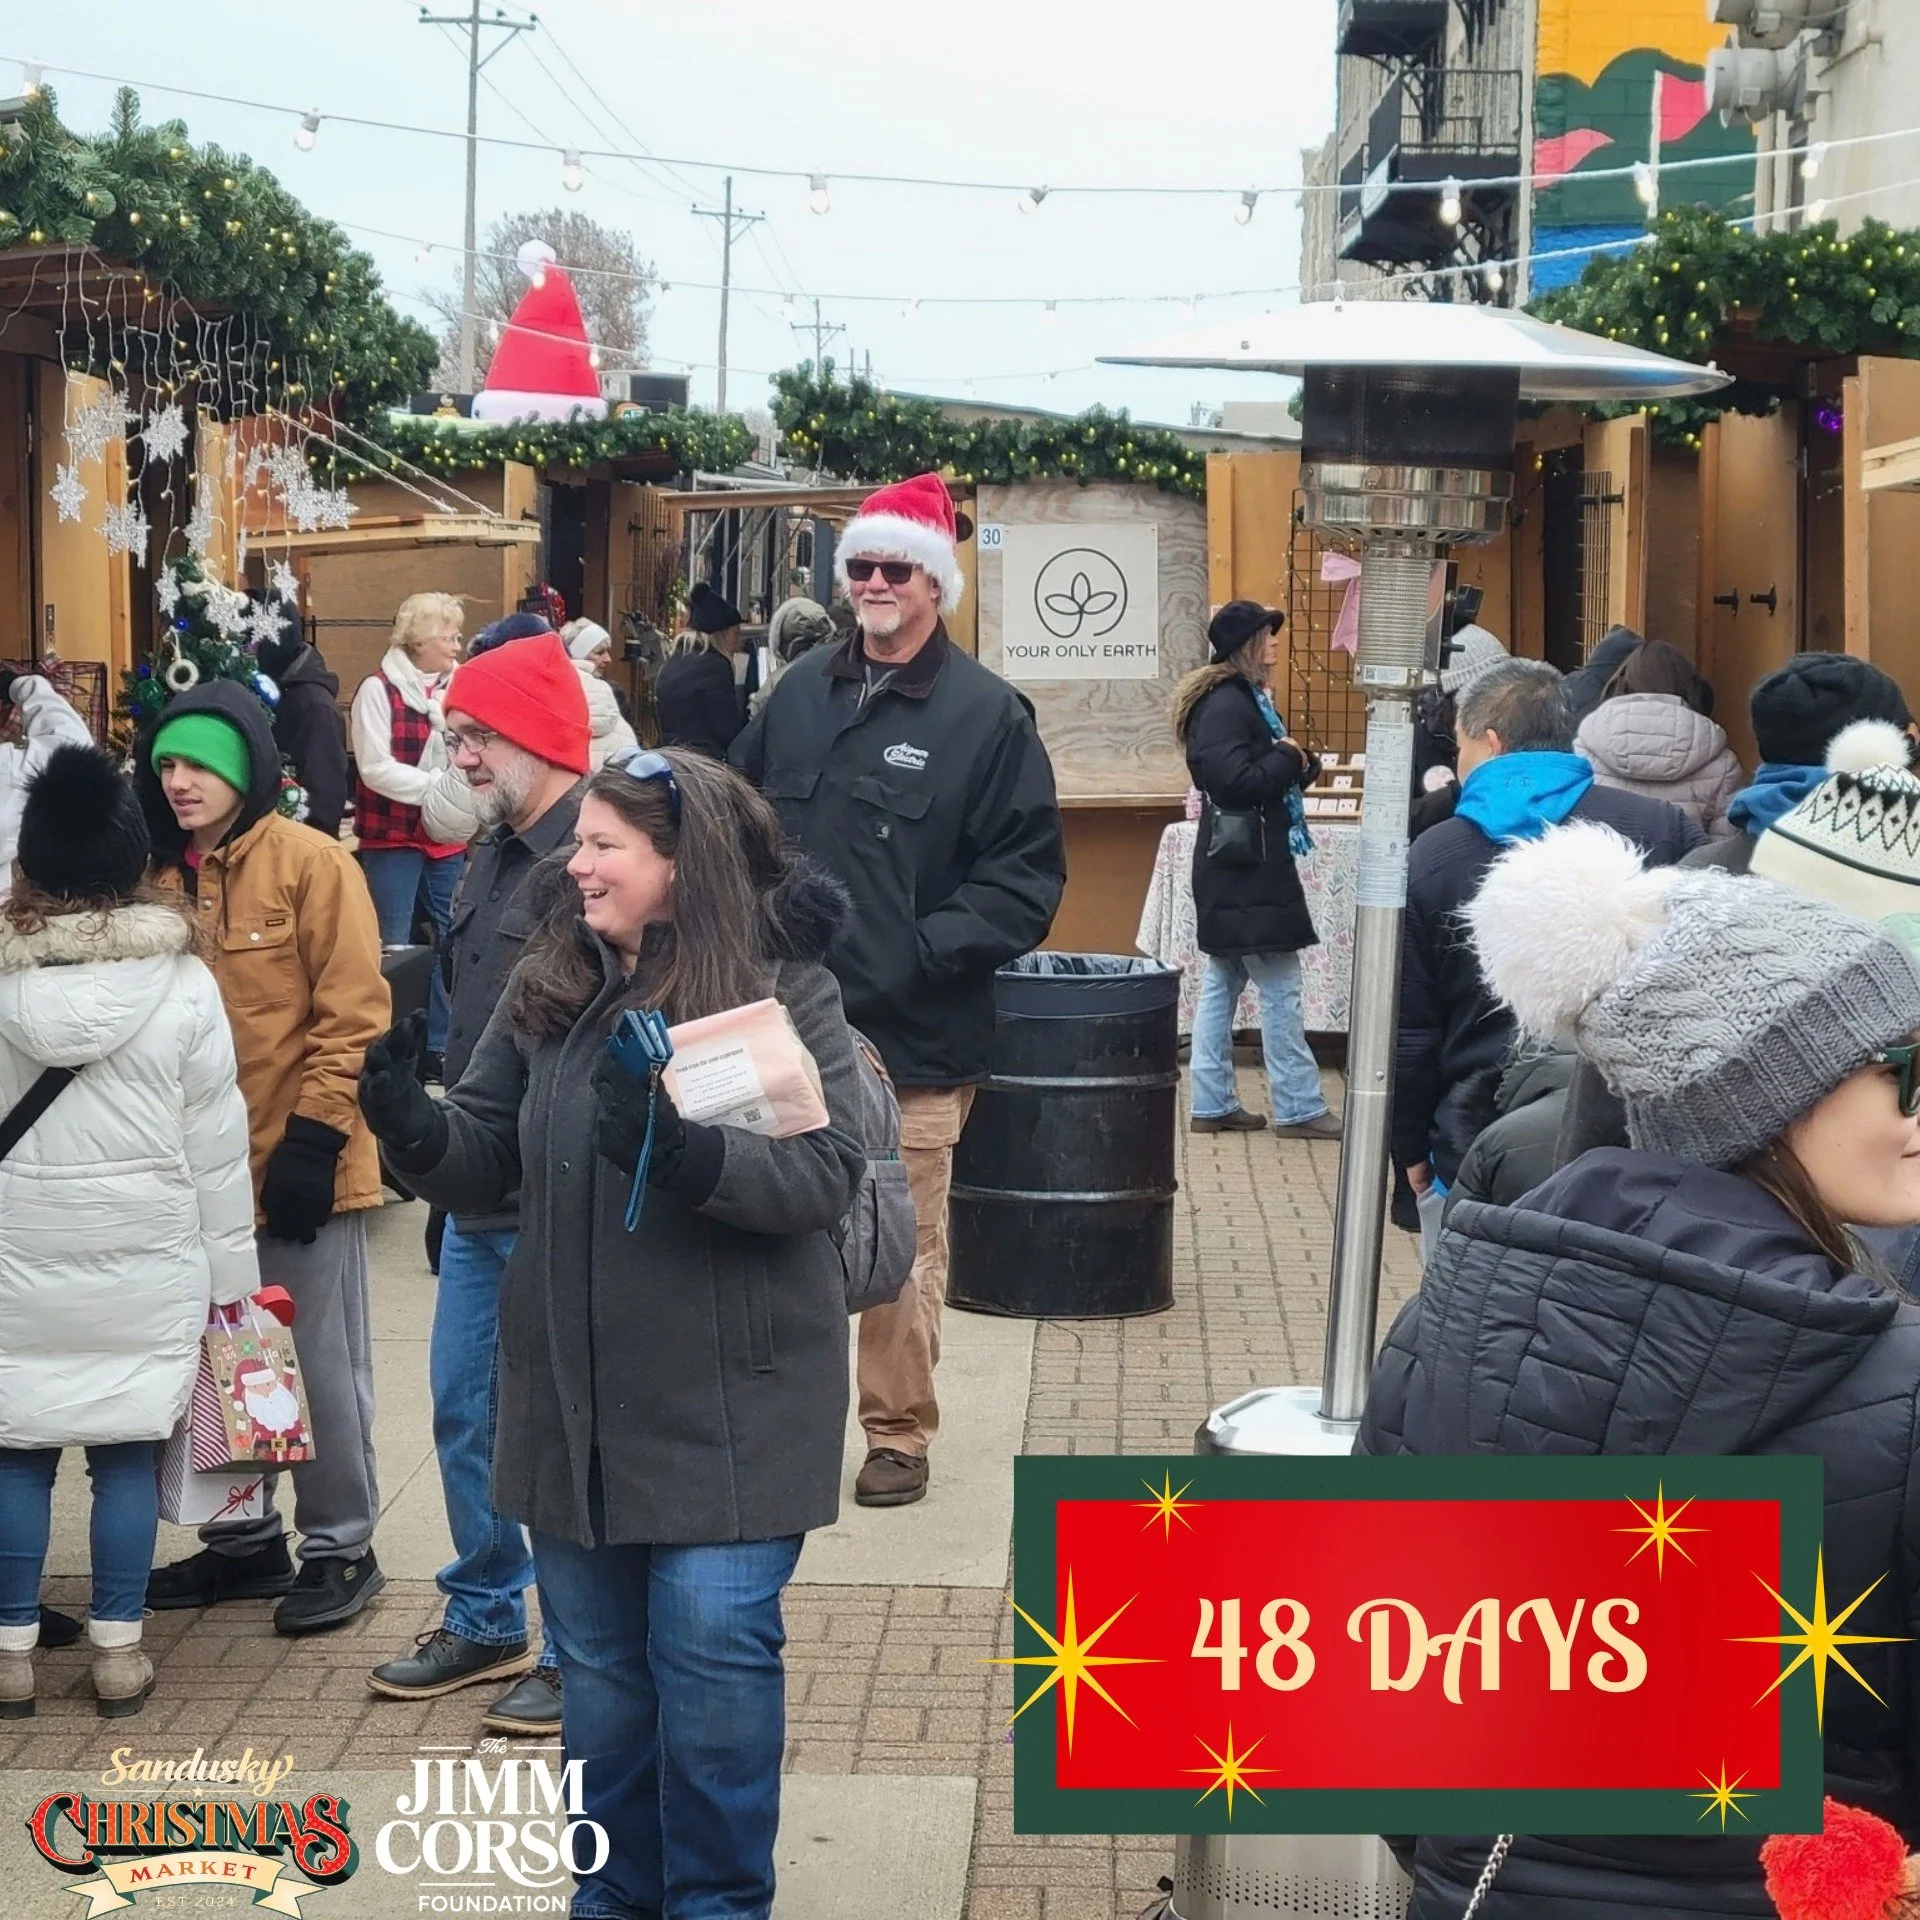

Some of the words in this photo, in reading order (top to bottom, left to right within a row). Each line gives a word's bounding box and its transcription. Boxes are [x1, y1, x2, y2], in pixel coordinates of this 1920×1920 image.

[982, 528, 1001, 545] 30
[1005, 645, 1050, 658] YOUR
[1055, 645, 1098, 658] ONLY
[1103, 644, 1157, 657] EARTH
